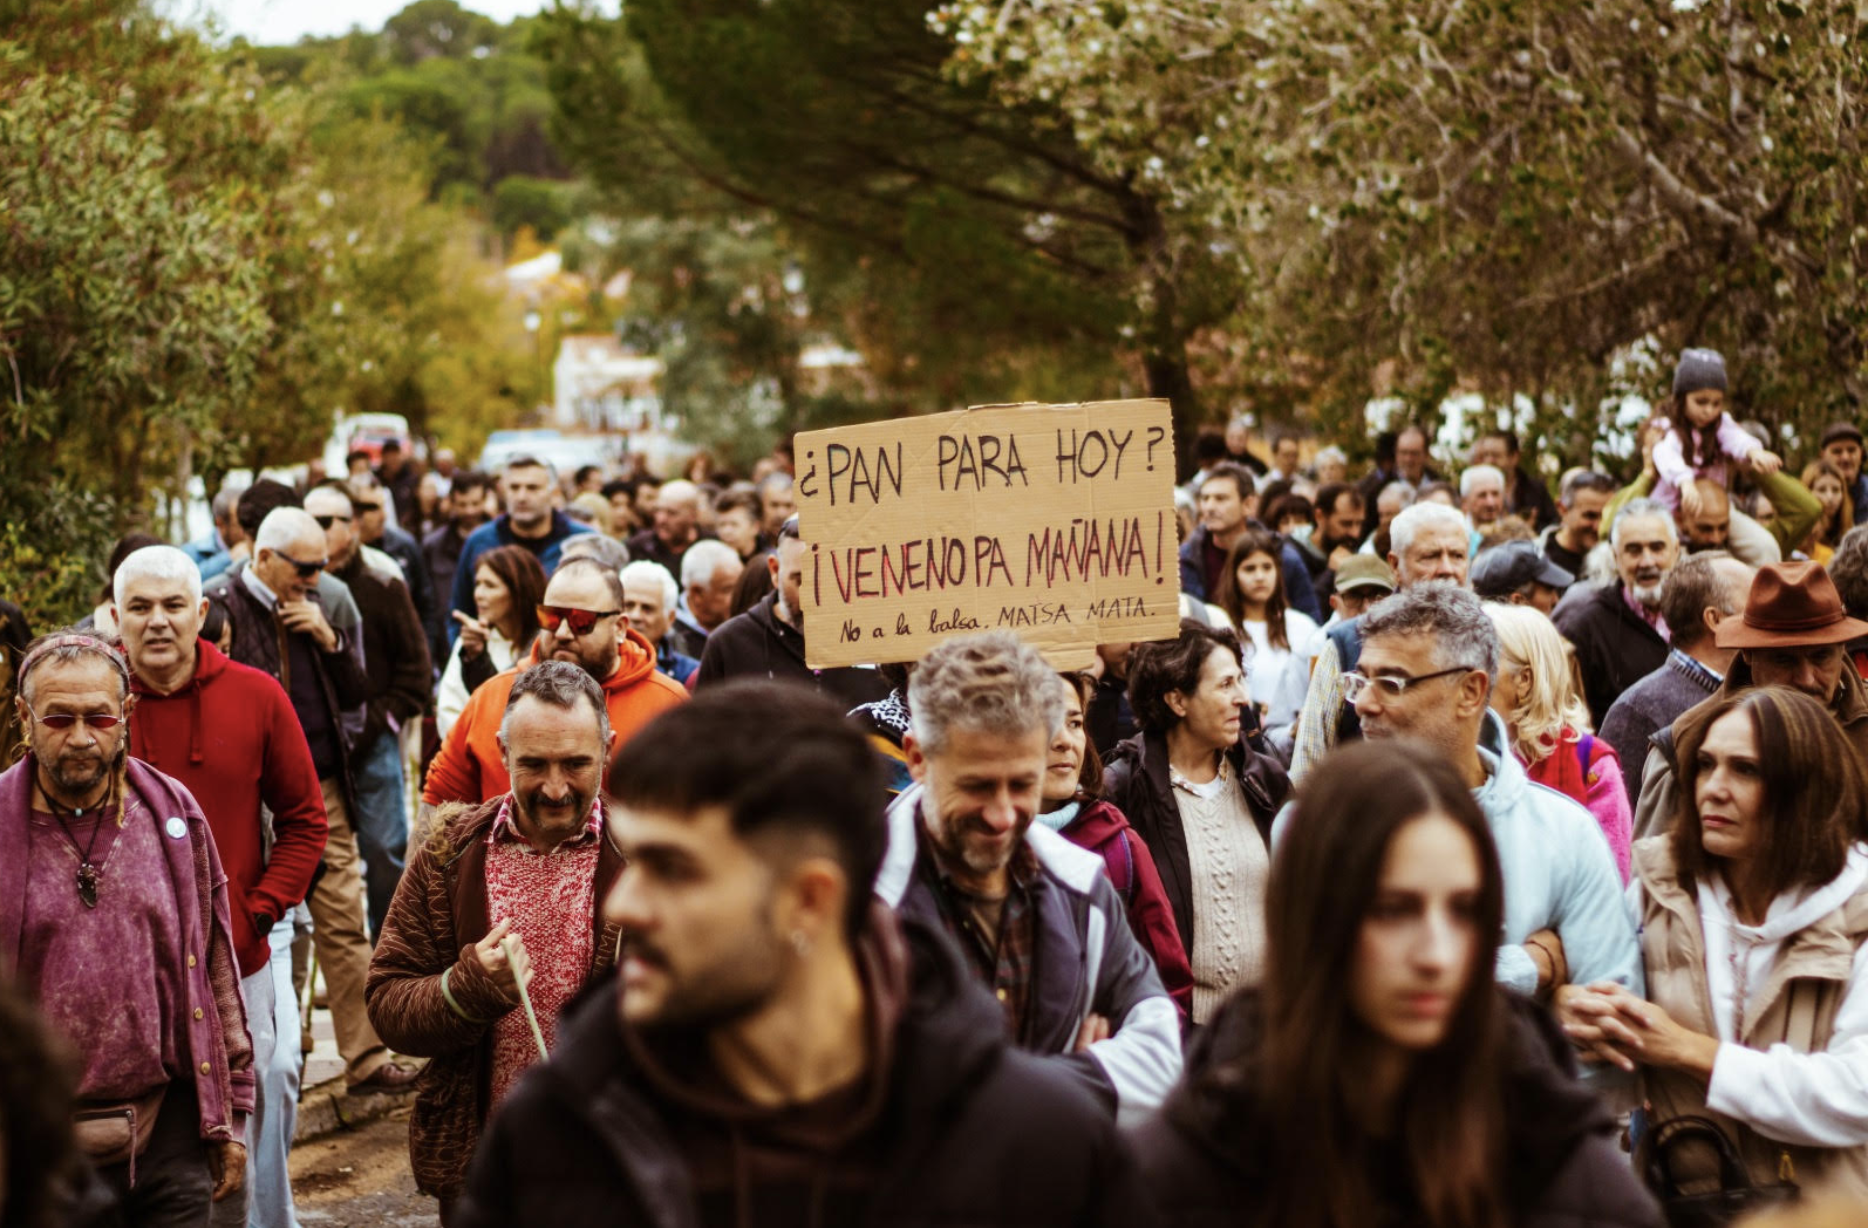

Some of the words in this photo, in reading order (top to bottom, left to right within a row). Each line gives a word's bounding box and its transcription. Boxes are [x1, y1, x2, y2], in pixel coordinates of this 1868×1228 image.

[938, 433, 1028, 491] PARA
[840, 620, 860, 643] No
[872, 626, 885, 638] a
[895, 613, 912, 636] la
[998, 602, 1071, 628] MATSA
